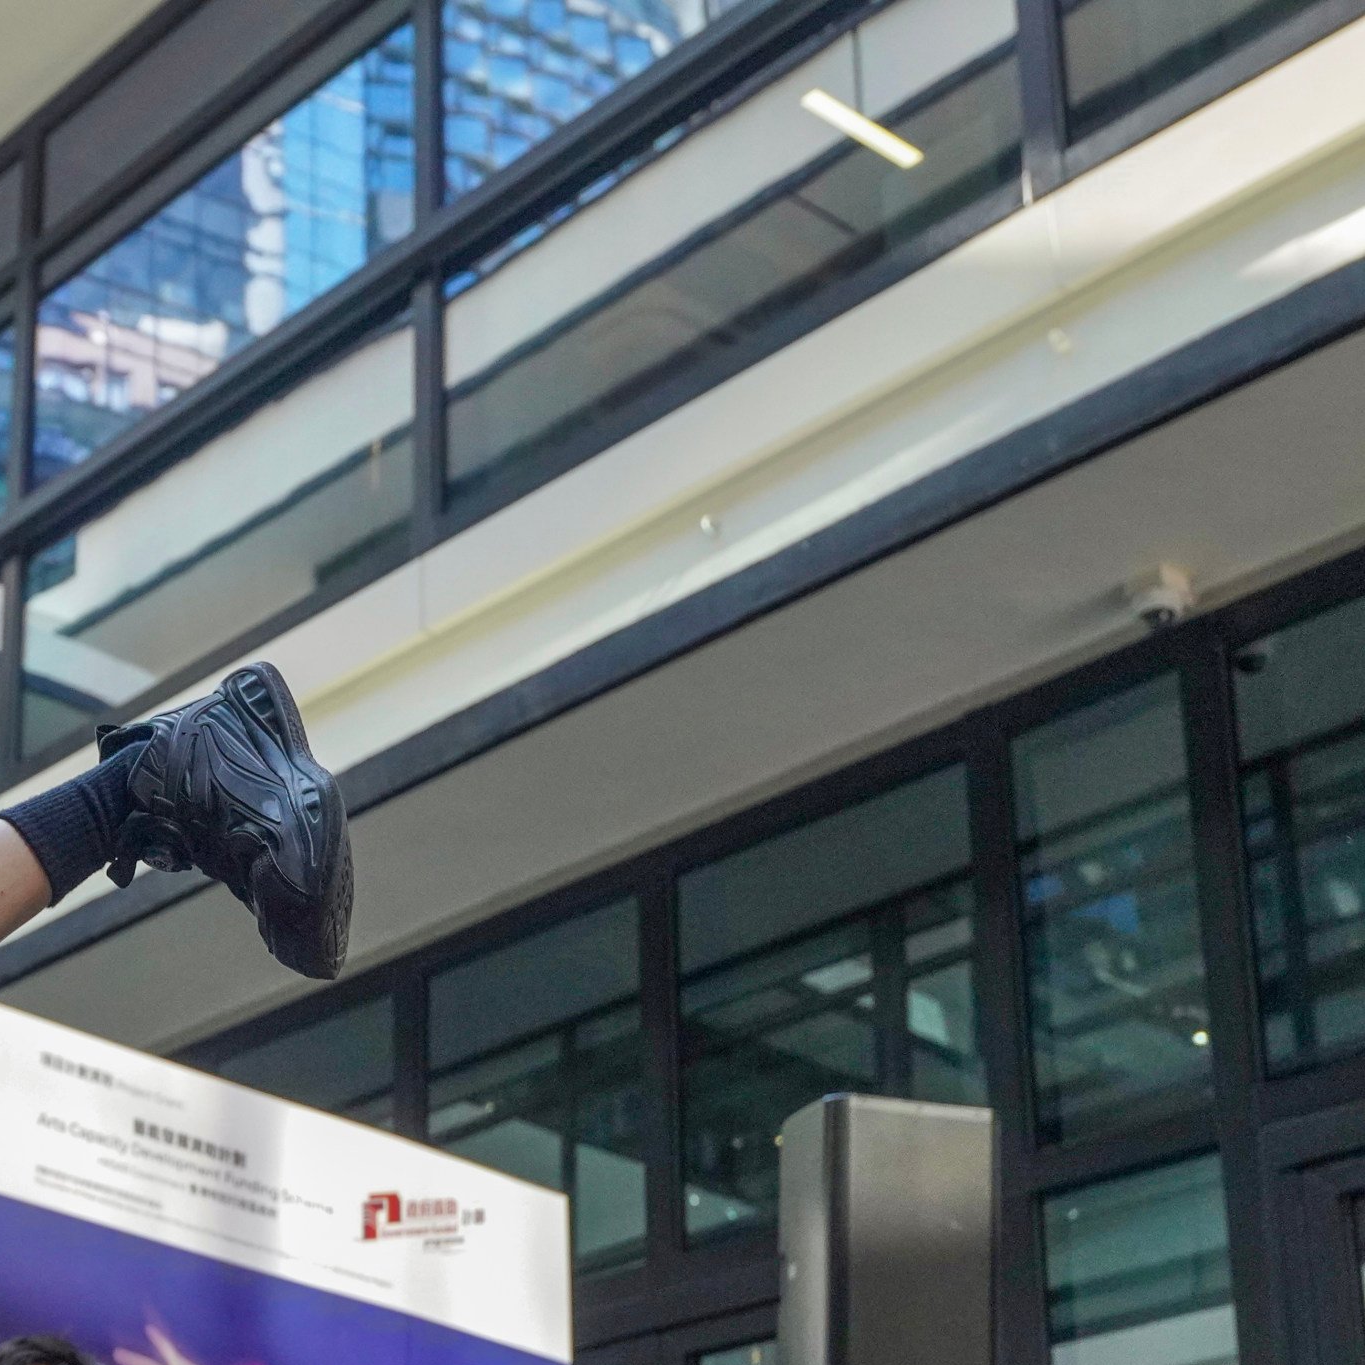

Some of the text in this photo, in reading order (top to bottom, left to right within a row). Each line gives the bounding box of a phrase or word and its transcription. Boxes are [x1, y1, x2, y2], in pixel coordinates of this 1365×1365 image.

[37, 1111, 67, 1134] Arts
[67, 1120, 128, 1156] Capacity
[130, 1139, 220, 1181] Development
[223, 1170, 279, 1202] Funding
